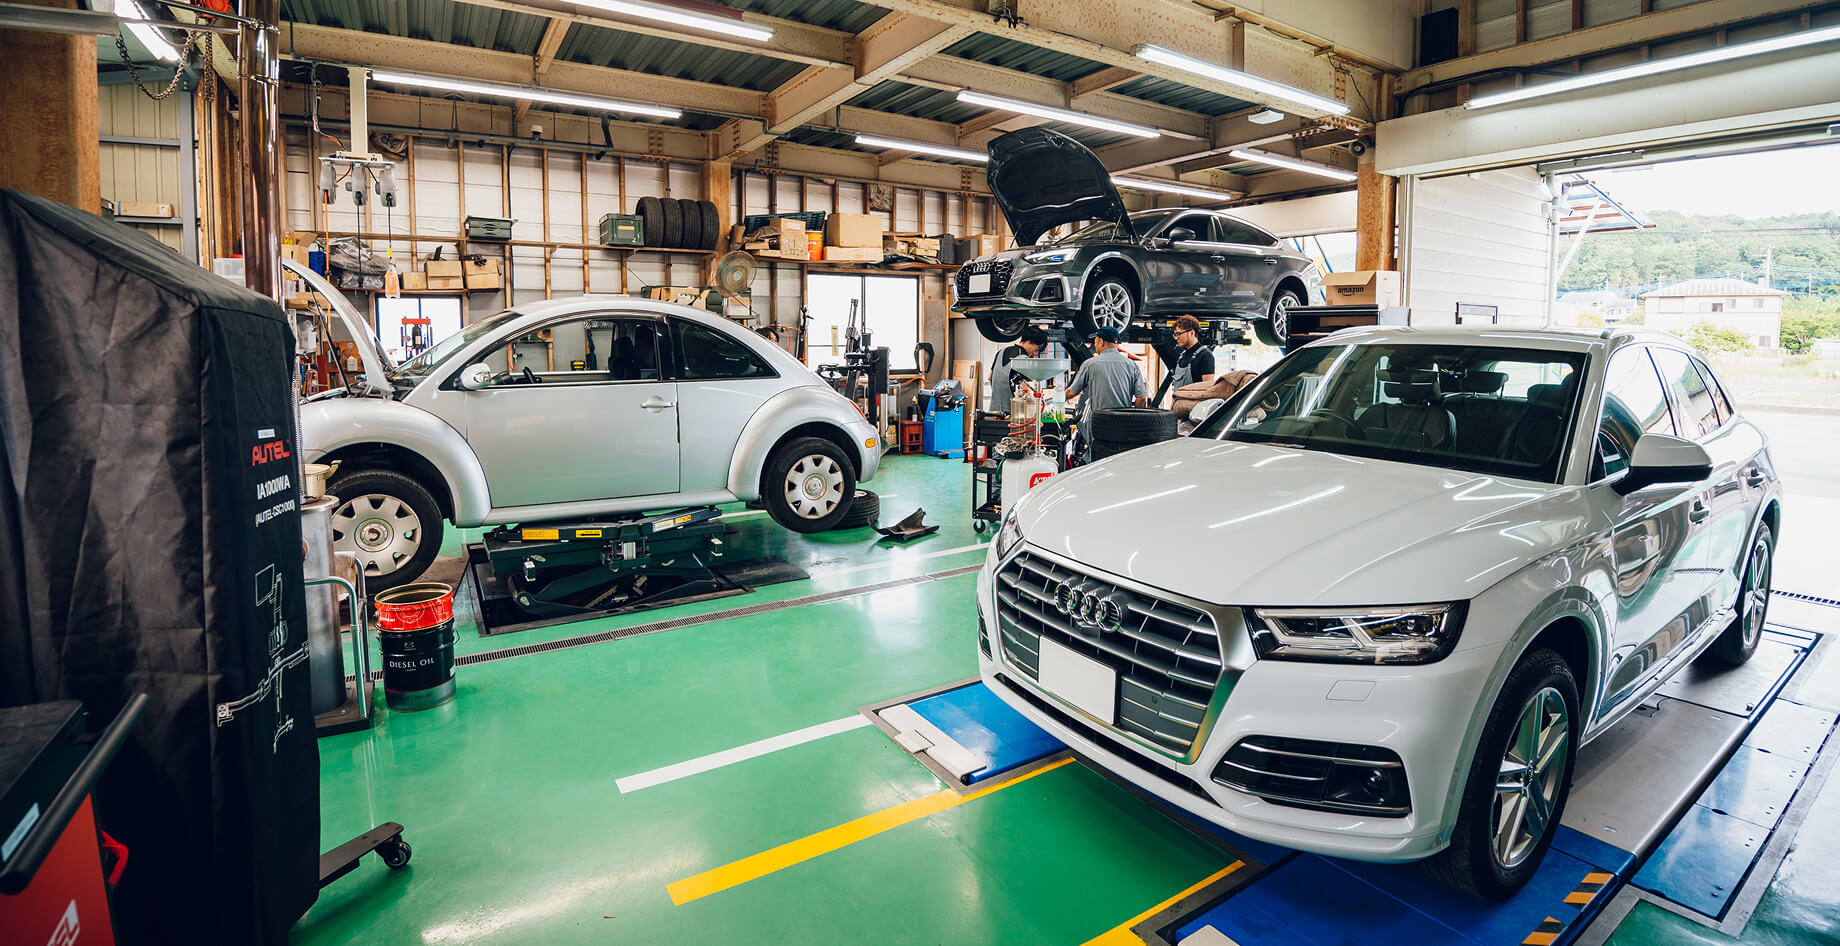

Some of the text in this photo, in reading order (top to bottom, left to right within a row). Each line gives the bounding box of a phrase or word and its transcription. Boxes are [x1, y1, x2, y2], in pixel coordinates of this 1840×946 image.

[1337, 286, 1364, 297] amazon
[252, 440, 290, 467] AUTEL
[420, 657, 435, 666] OIL
